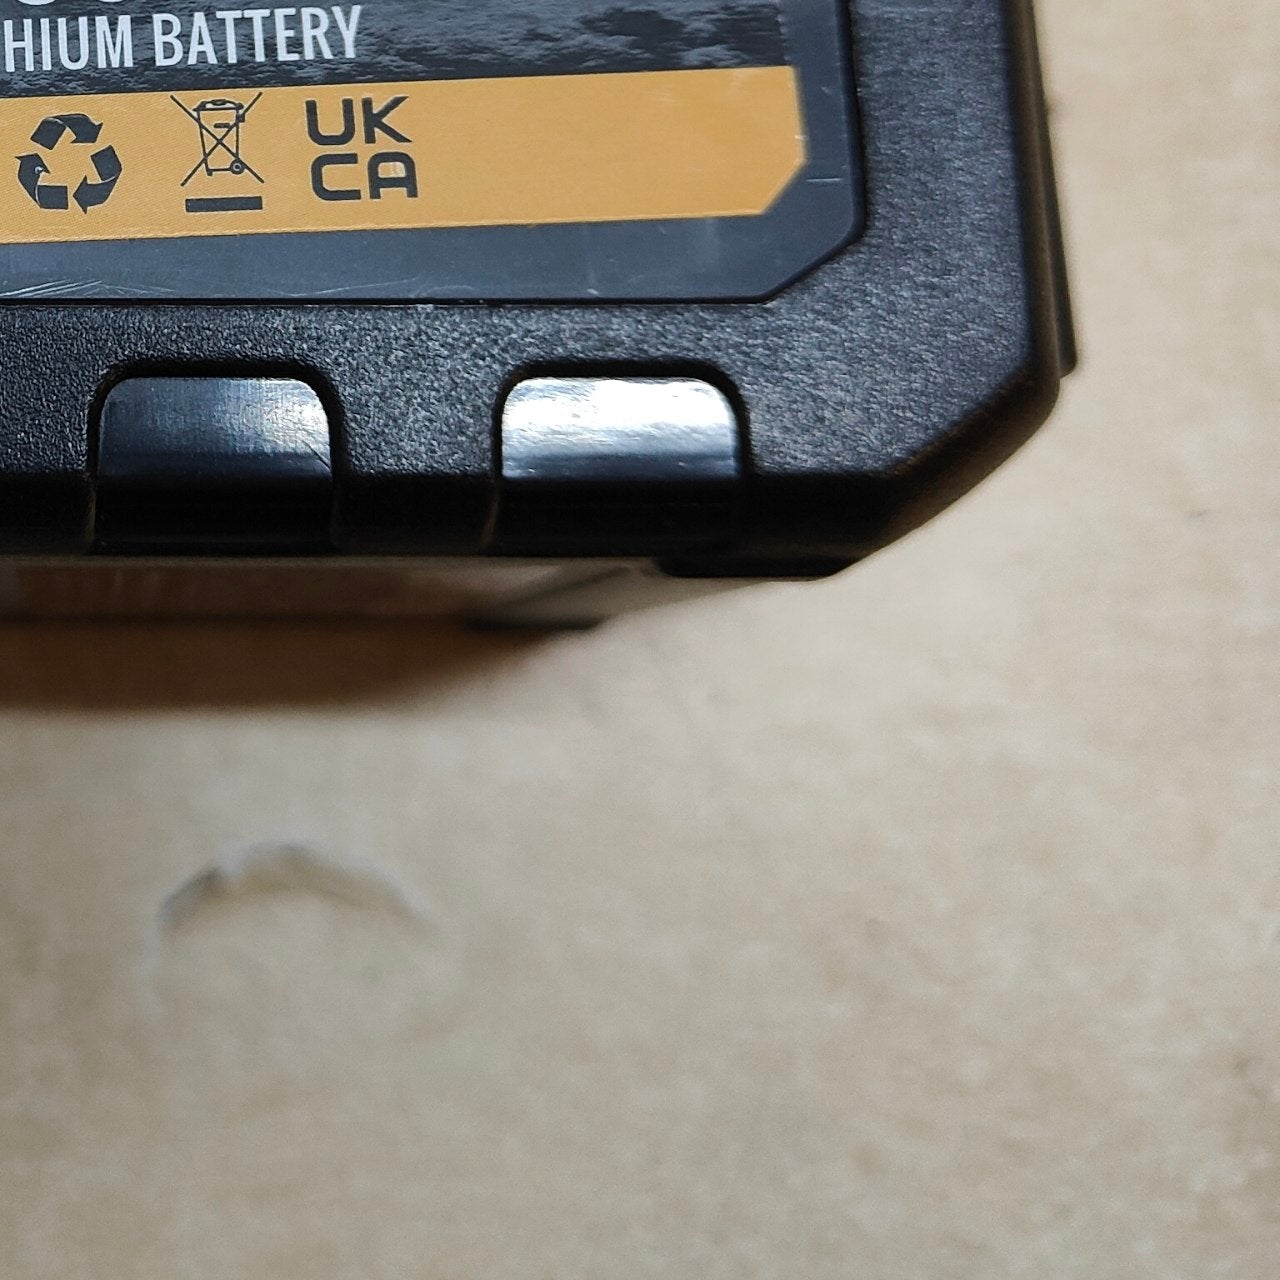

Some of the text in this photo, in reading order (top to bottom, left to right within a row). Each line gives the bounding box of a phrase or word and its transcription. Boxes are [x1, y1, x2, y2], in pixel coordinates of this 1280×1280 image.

[153, 5, 362, 68] BATTERY
[306, 96, 410, 144] UK
[311, 152, 419, 202] CA
